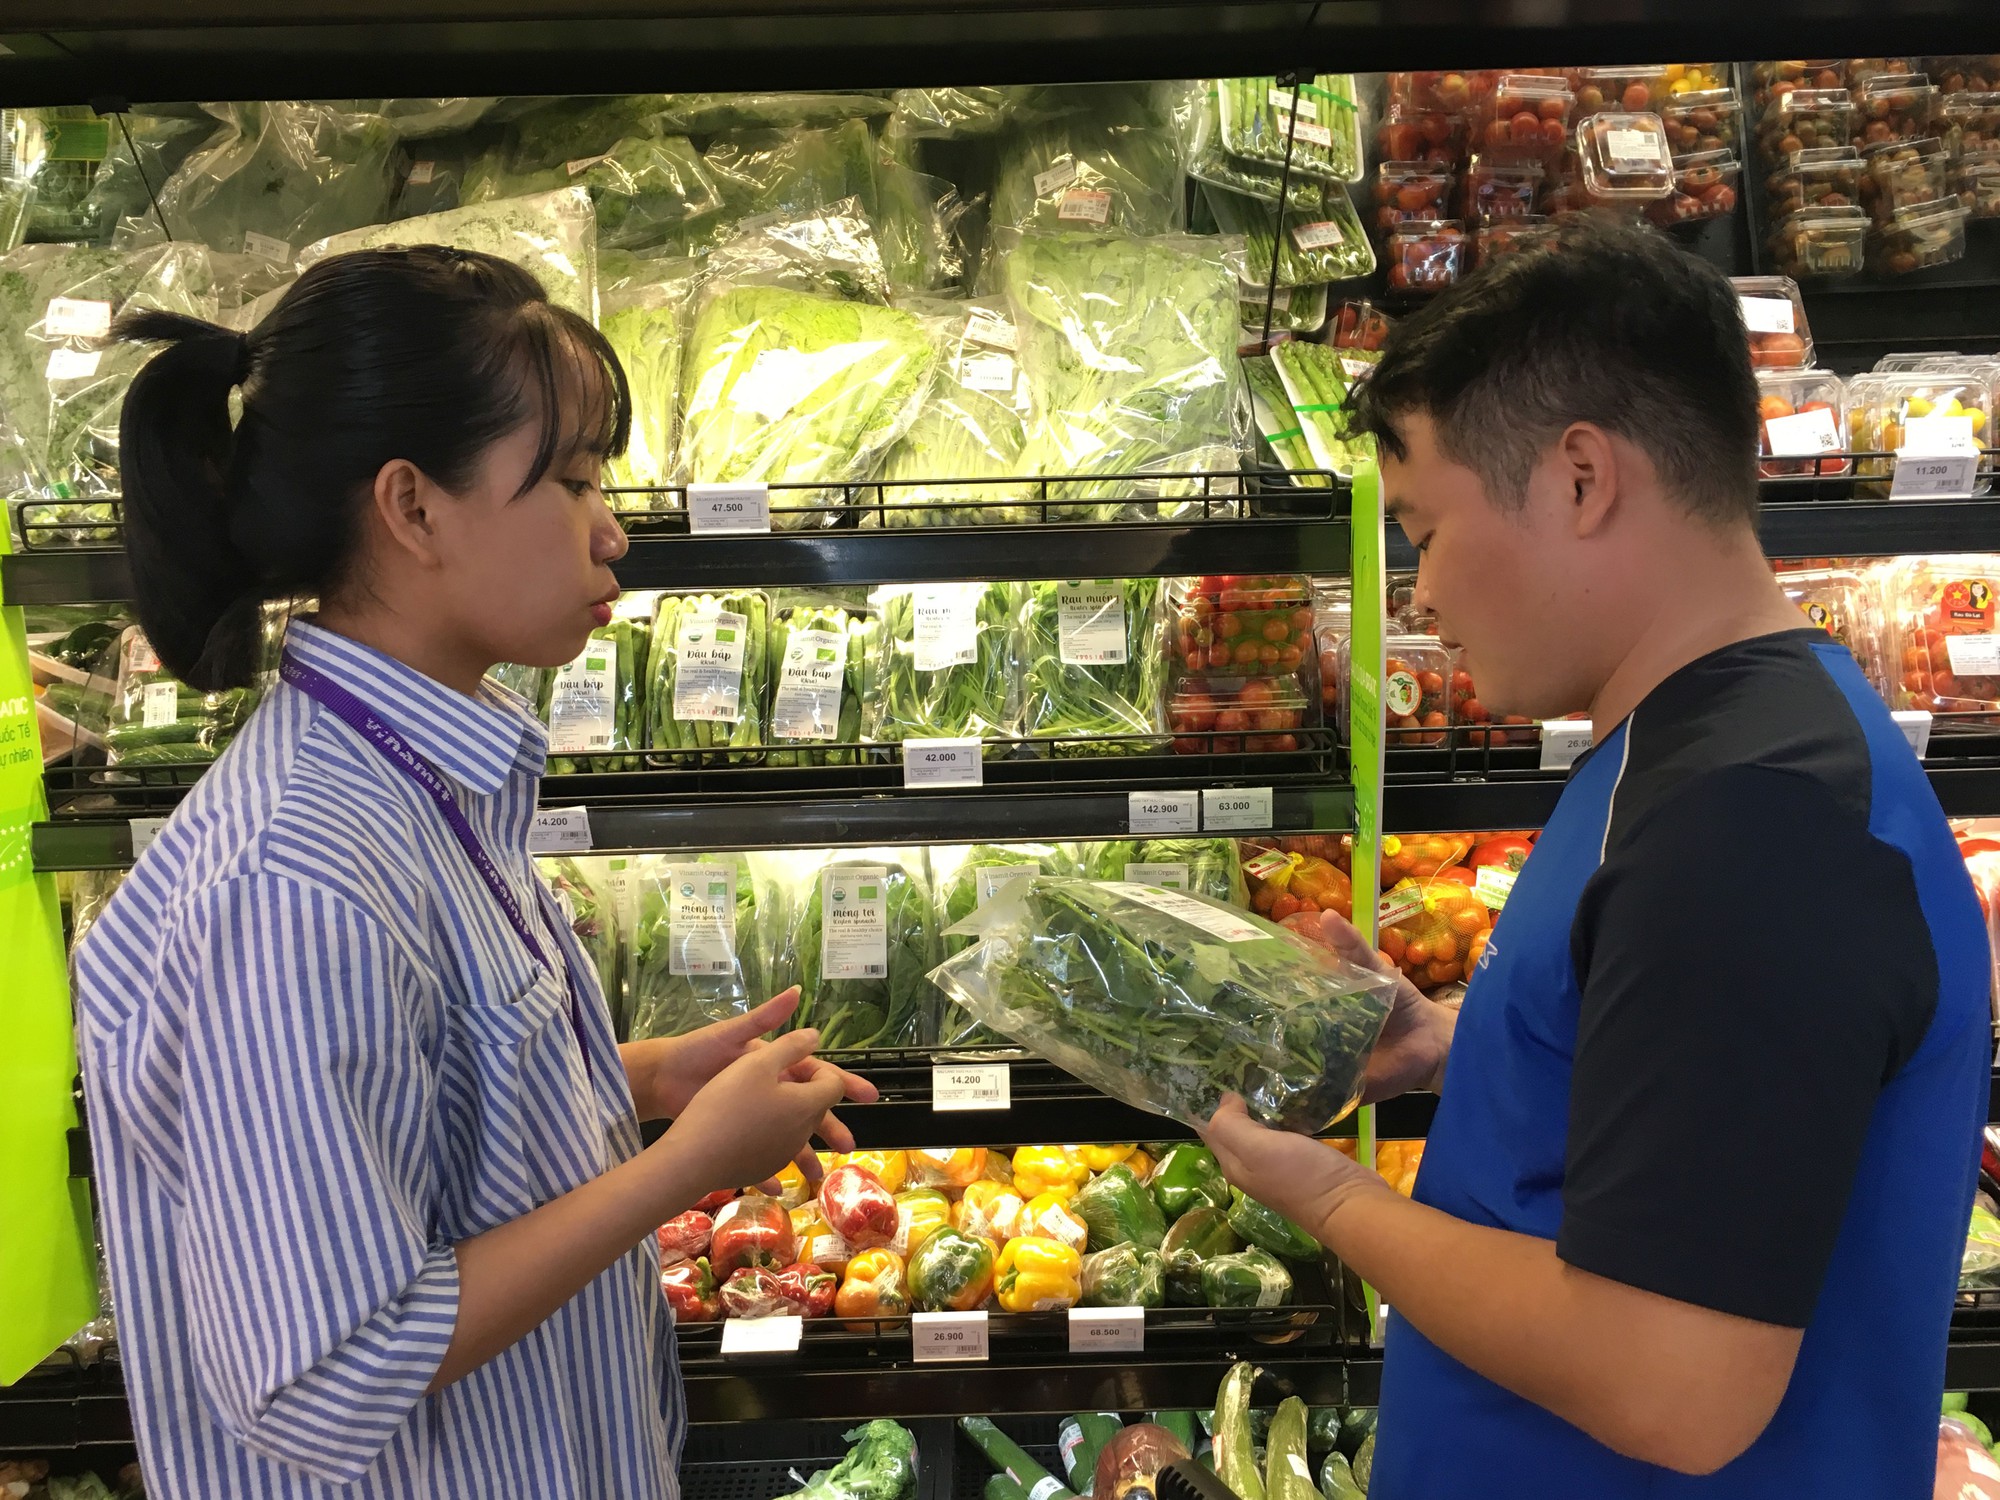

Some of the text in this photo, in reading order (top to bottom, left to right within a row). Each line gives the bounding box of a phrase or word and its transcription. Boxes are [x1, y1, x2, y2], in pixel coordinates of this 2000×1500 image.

[1916, 465, 1948, 475] 11.200
[712, 503, 743, 512] 47.500
[714, 618, 738, 626] Organic
[1567, 739, 1593, 748] 26.90
[925, 753, 956, 762] 42.000
[1142, 804, 1178, 813] 142.900
[1218, 802, 1250, 811] 63.000
[537, 817, 568, 826] 14.200
[855, 873, 879, 881] Organic
[951, 1075, 981, 1084] 14.200
[934, 1332, 964, 1341] 26.900
[1090, 1328, 1120, 1336] 68.500
